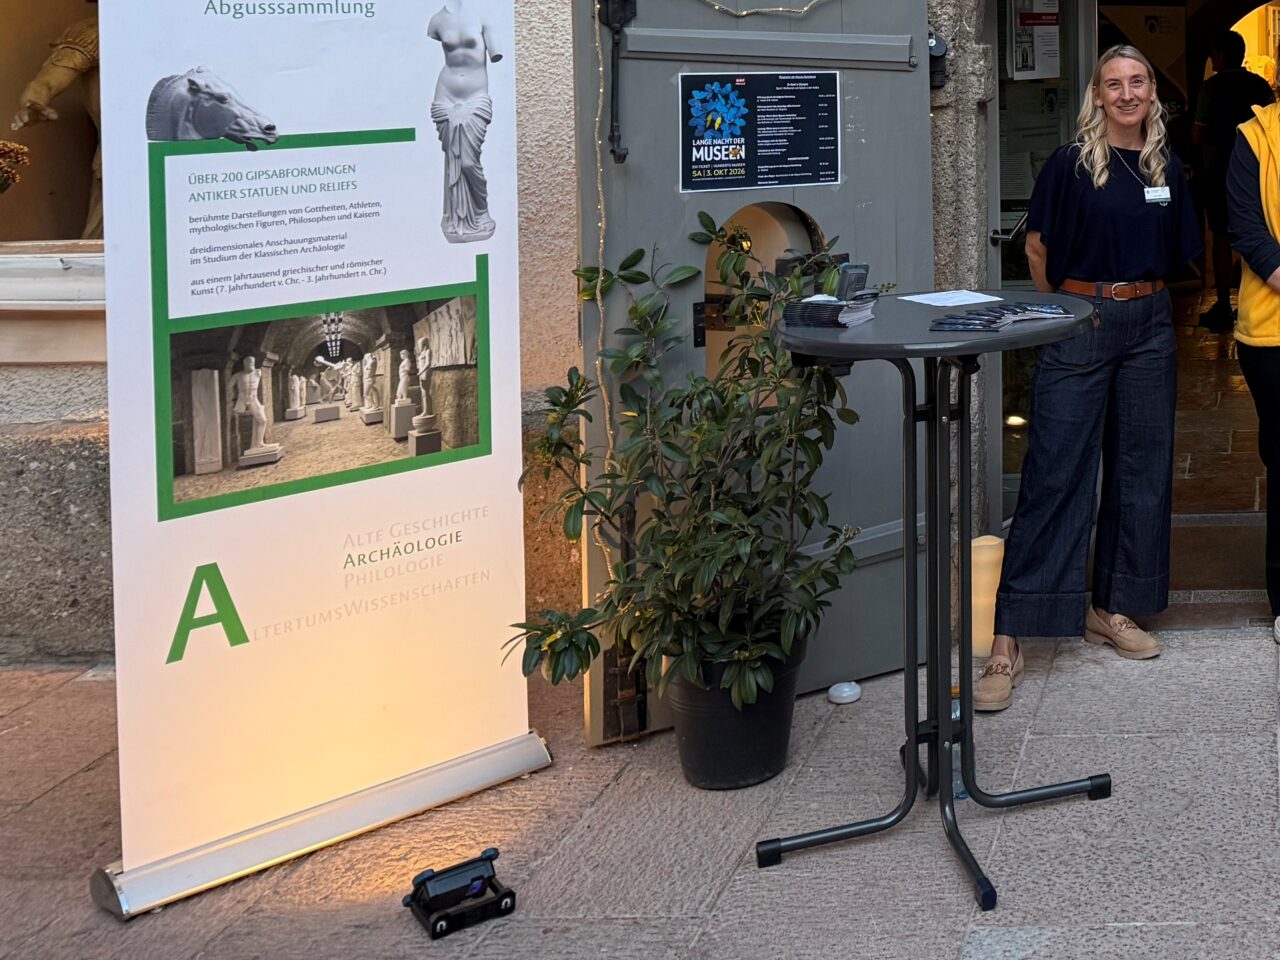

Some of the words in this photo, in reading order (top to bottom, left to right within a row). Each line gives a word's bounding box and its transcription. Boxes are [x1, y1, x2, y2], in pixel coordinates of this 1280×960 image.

[692, 138, 712, 146] LANGE
[692, 144, 746, 162] MUSEEN
[188, 173, 219, 185] ÜBER
[221, 171, 243, 183] 200
[245, 164, 356, 181] GIPSABFORMUNGEN
[188, 189, 237, 202] ANTIKER
[240, 186, 288, 199] STATUEN
[291, 183, 317, 195] UND
[319, 180, 358, 192] RELIEFS
[189, 212, 230, 224] berühmte
[231, 208, 287, 221] Darstellungen
[304, 204, 348, 214] Gottheiten,
[348, 200, 382, 210] Athleten,
[189, 221, 254, 234] mythologischen
[256, 218, 288, 230] Figuren,
[288, 214, 336, 226] Philosophen
[354, 210, 380, 218] Kaisern
[190, 241, 264, 255] dreidimensionales
[265, 232, 348, 249] Anschauungsmaterial
[202, 254, 237, 264] Studium
[239, 252, 252, 260] der
[254, 247, 299, 258] Klassischen
[300, 242, 346, 255] Archäologie
[191, 286, 214, 296] Kunst
[215, 284, 228, 295] (7.
[228, 280, 276, 294] Jahrhundert
[285, 276, 300, 286] Chr.
[306, 276, 314, 284] 3.
[314, 270, 360, 283] Jahrhundert
[368, 266, 387, 277] Chr.)
[206, 276, 232, 285] einem
[233, 268, 280, 283] Jahrtausend
[282, 264, 328, 278] griechischer
[330, 262, 345, 270] und
[346, 258, 384, 268] römischer
